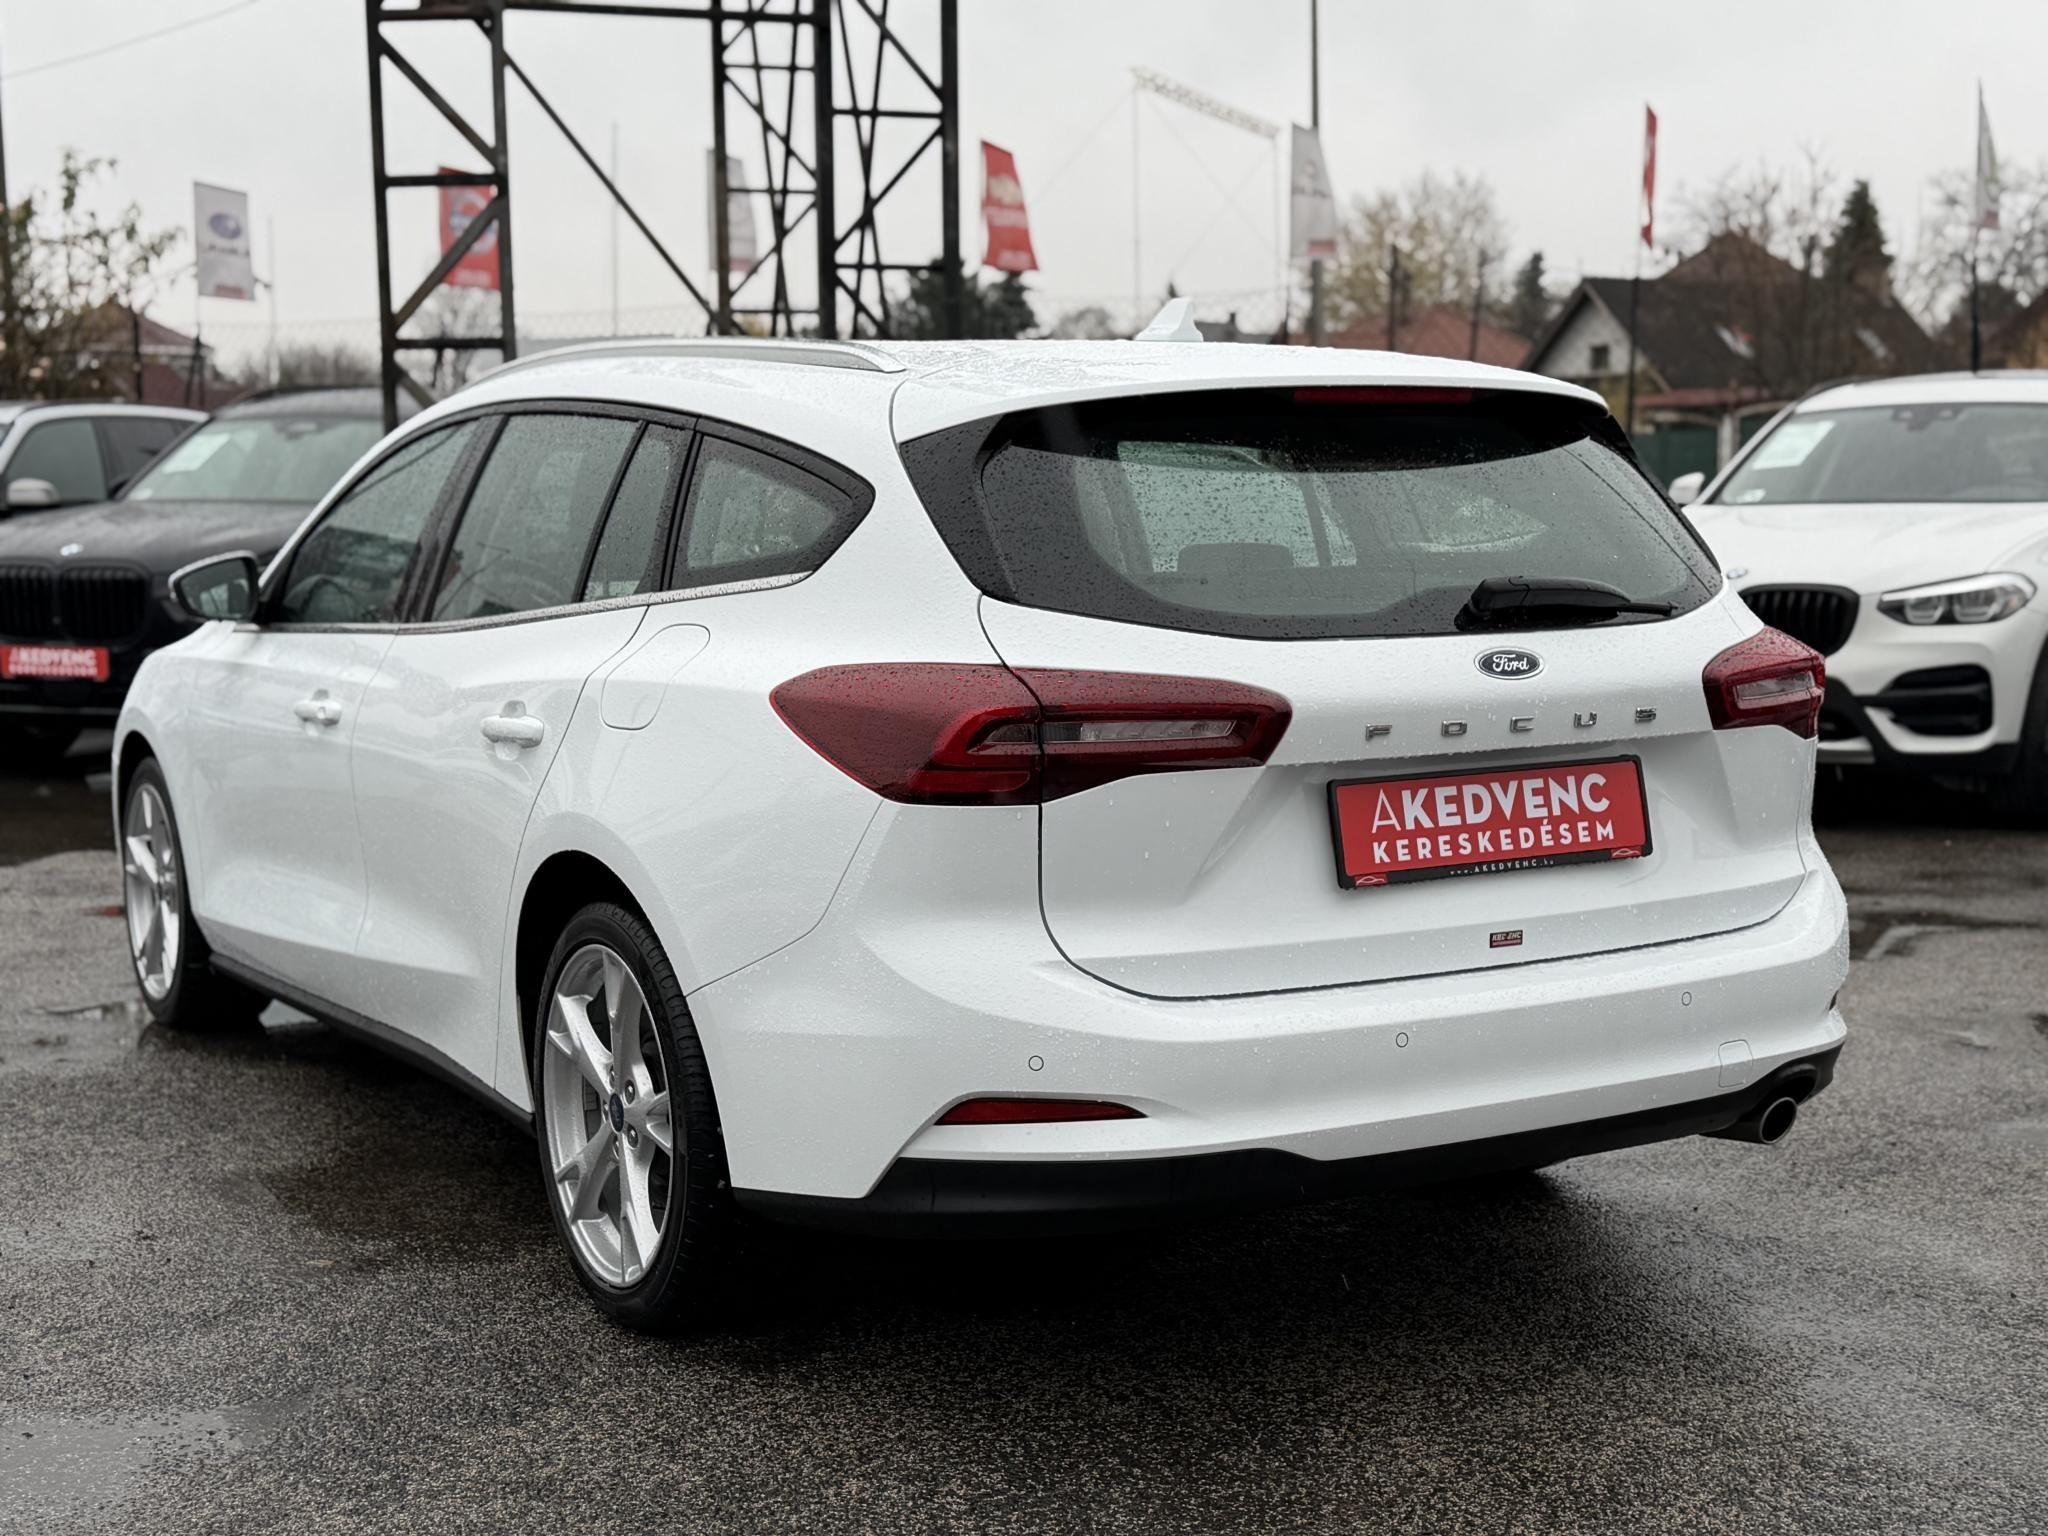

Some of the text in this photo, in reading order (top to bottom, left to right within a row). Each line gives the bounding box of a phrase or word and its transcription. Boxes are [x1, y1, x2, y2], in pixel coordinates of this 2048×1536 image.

[1492, 654, 1530, 671] Ford
[1365, 706, 1657, 740] FOCUS
[1371, 773, 1610, 834] AKEDVENC
[1372, 818, 1615, 864] KERESKEDÉSEM
